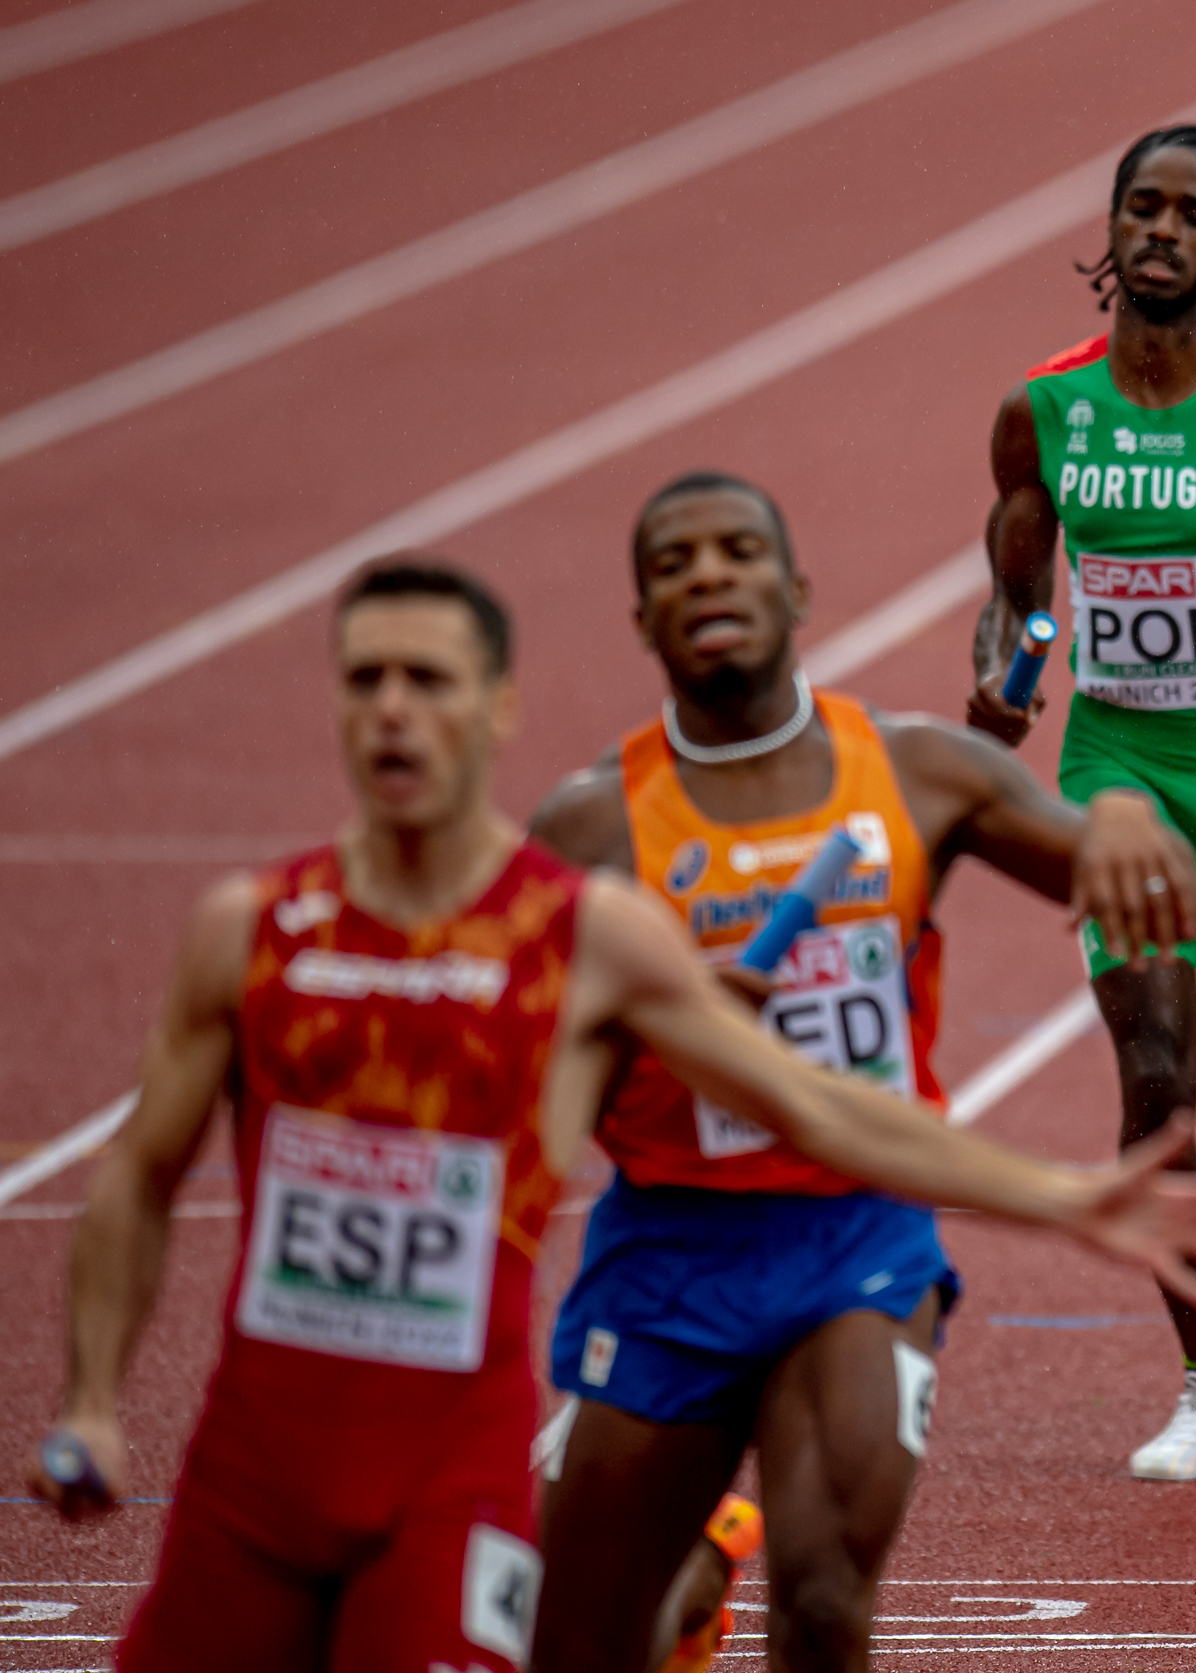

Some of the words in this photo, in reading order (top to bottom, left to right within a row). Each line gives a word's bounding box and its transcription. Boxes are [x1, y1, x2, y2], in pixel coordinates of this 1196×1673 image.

[1082, 563, 1195, 595] SPAR
[1088, 683, 1182, 705] MUNICH
[774, 995, 888, 1065] ED
[276, 1189, 463, 1295] ESP
